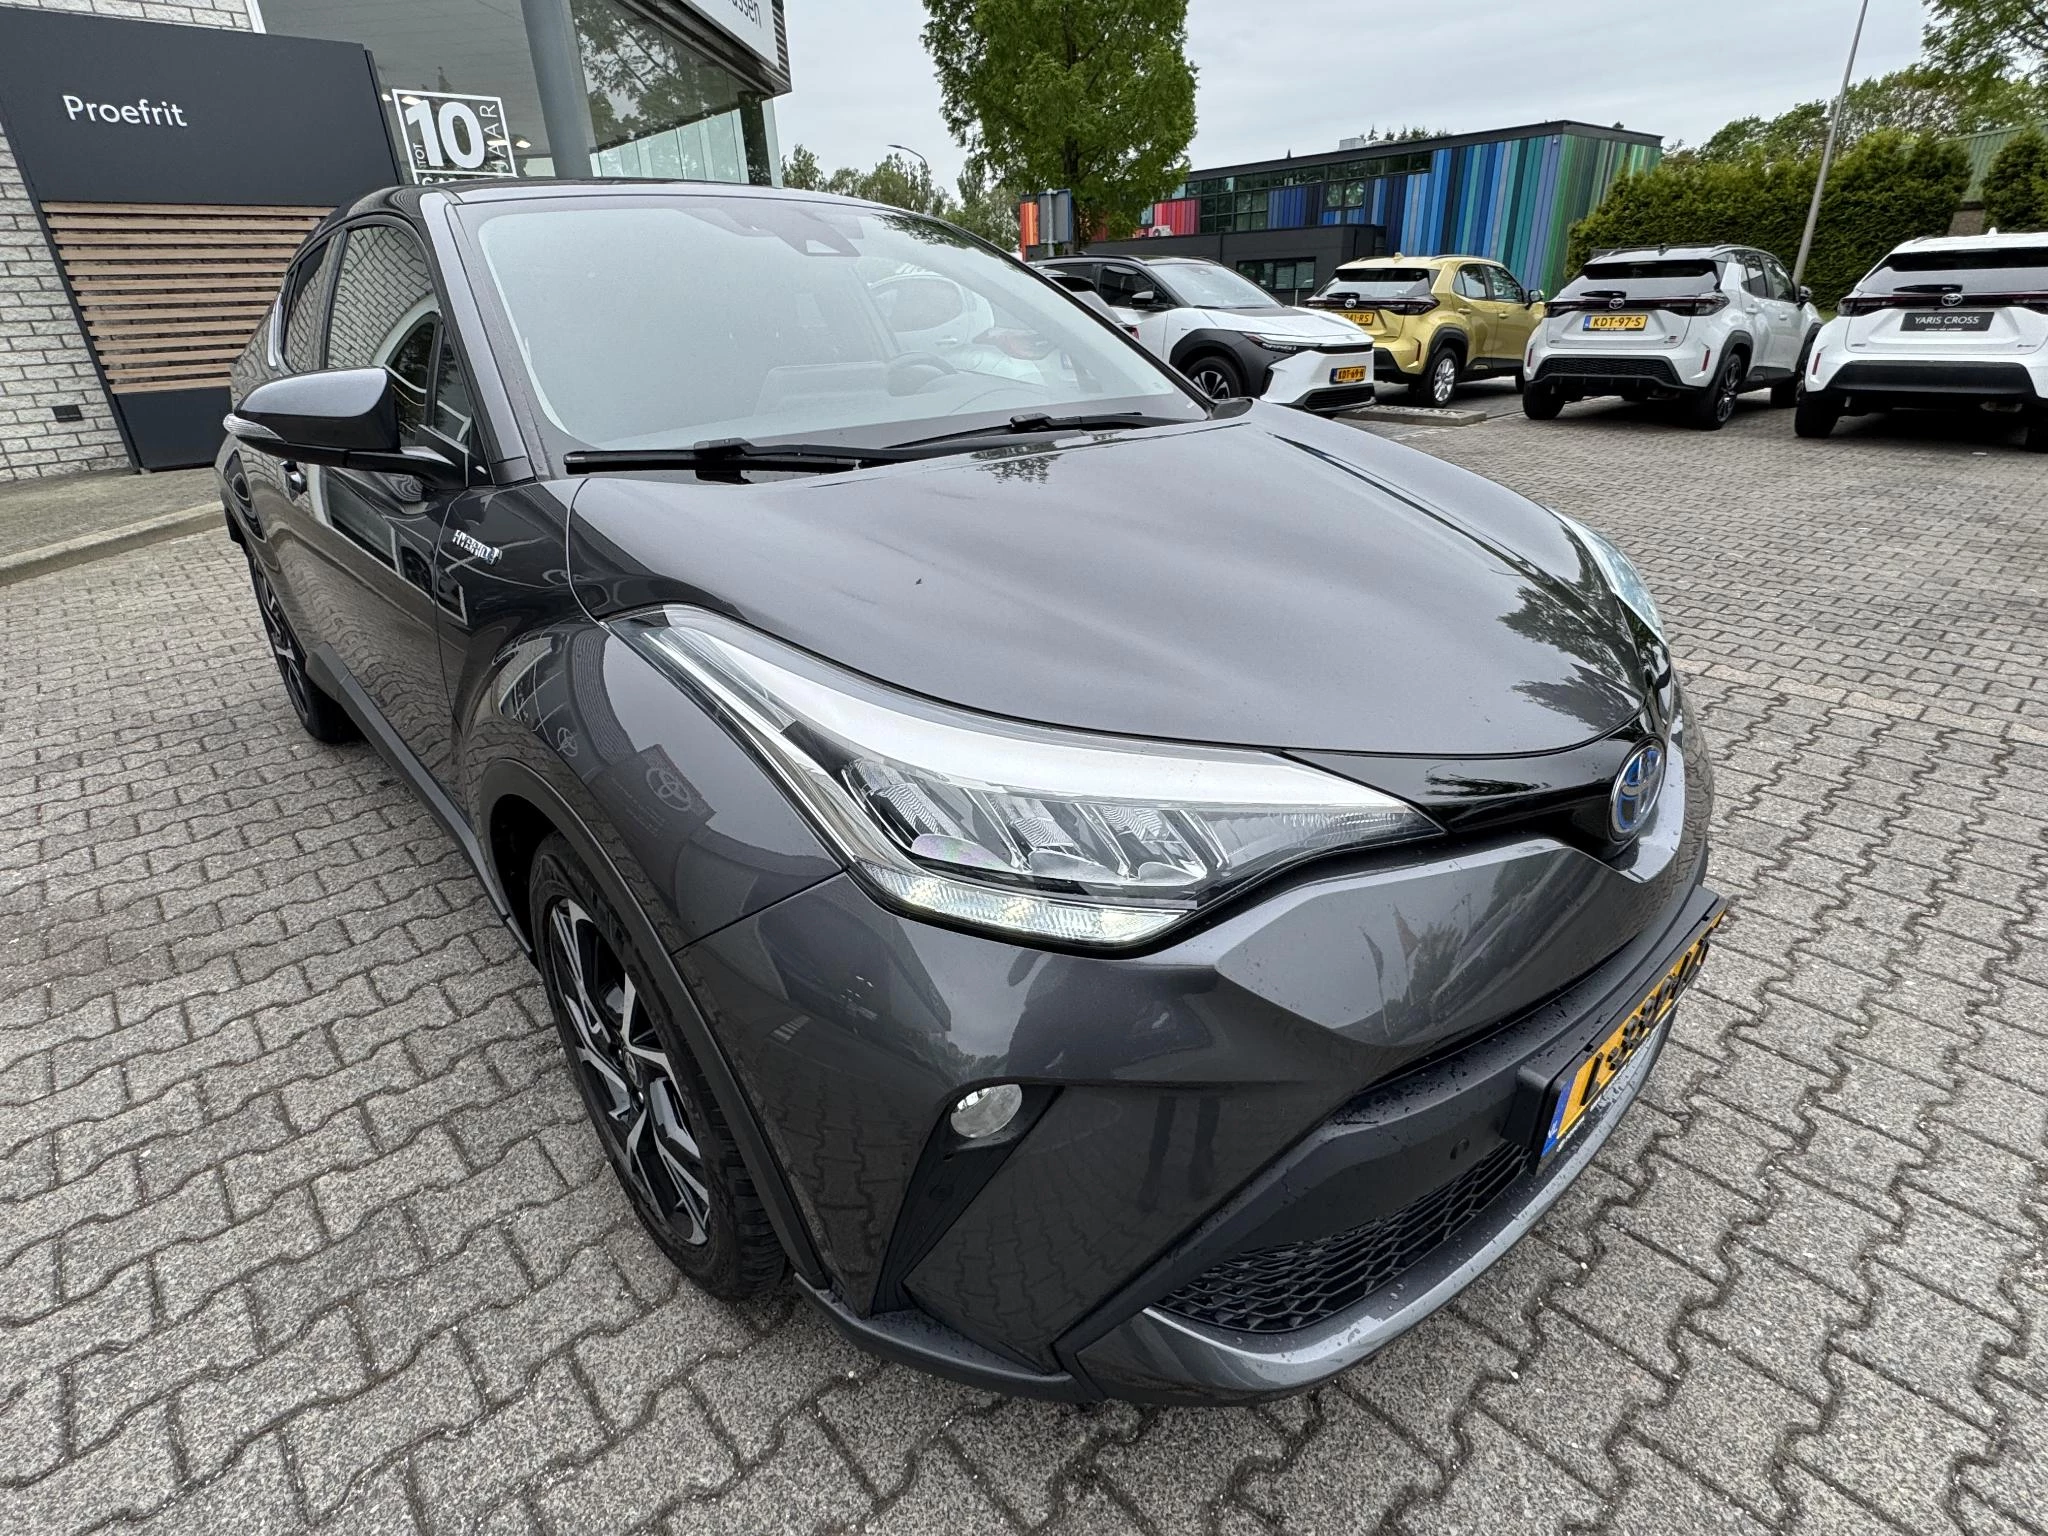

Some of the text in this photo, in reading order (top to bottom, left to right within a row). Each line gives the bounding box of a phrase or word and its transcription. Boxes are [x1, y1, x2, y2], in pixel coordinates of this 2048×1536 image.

[62, 95, 188, 127] Proefrit
[405, 99, 509, 170] TOT 10 JAAR
[1593, 316, 1643, 327] KDT-97-S
[1914, 316, 1980, 325] YARIS CROSS
